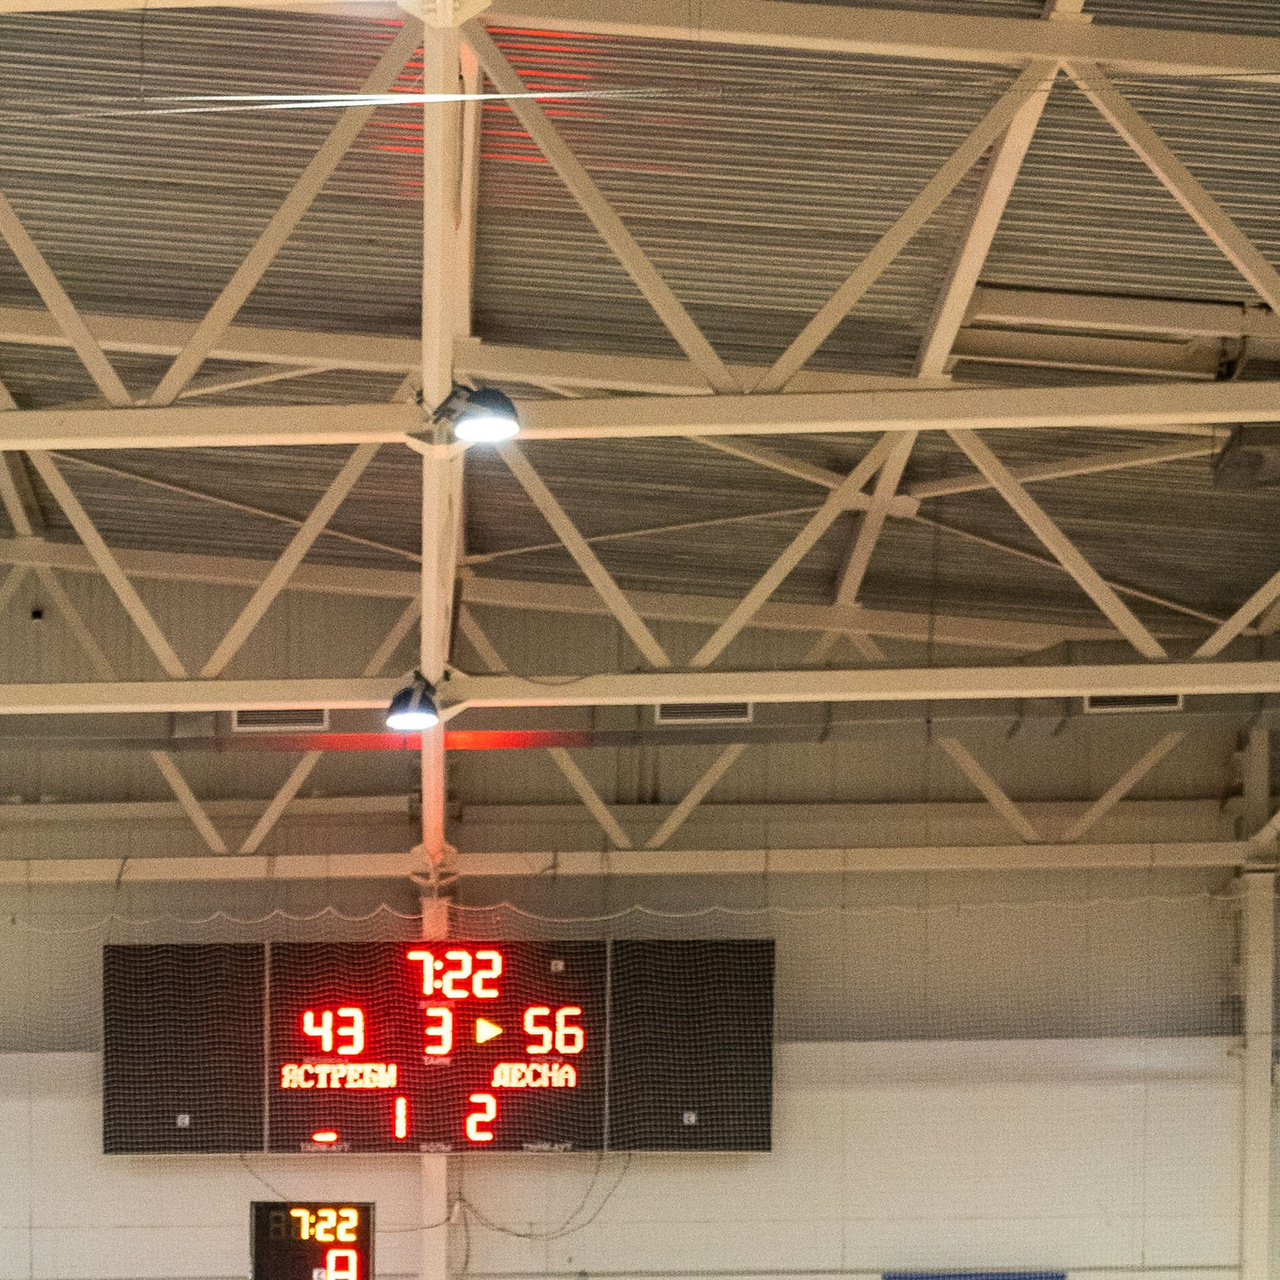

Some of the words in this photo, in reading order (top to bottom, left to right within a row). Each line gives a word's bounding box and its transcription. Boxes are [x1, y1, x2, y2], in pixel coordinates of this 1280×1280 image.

[407, 949, 503, 999] 7:22
[303, 1006, 365, 1056] 43
[425, 1006, 453, 1055] 3
[523, 1006, 585, 1055] 56
[491, 1062, 578, 1088] ДЕСНА
[395, 1097, 407, 1139] 1
[466, 1093, 497, 1141] 2
[290, 1208, 359, 1242] 7:22
